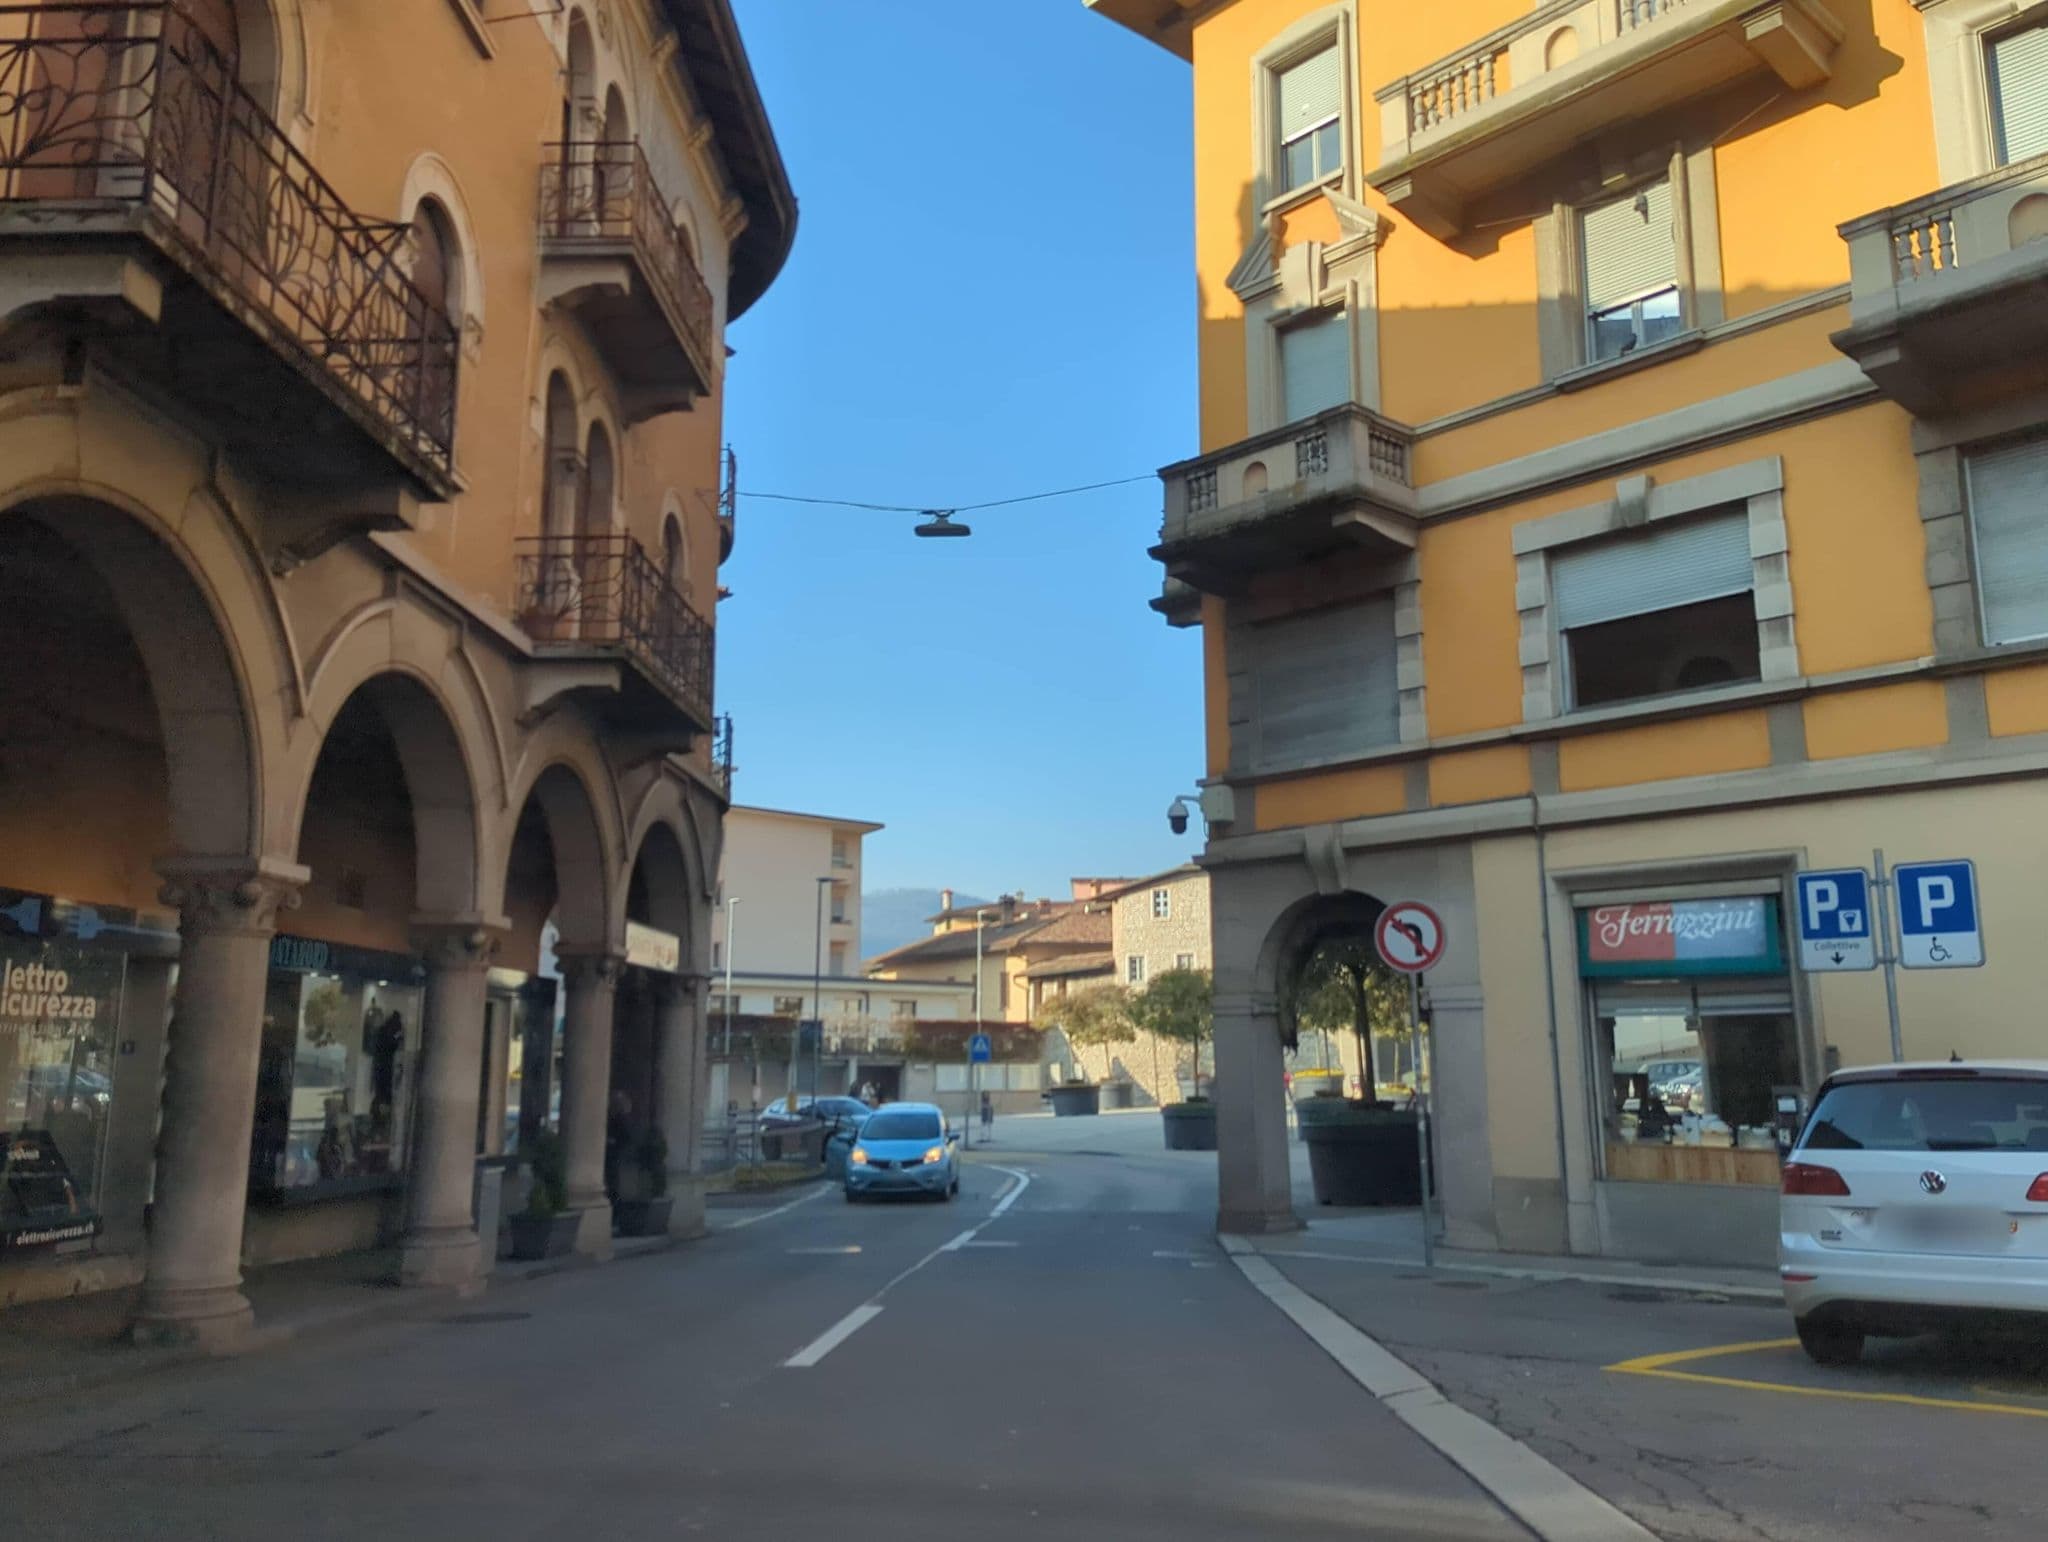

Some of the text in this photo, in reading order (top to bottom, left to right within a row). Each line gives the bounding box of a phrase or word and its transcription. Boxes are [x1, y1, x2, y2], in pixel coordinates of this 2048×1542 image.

[1594, 901, 1754, 948] Ferrazzini
[1806, 880, 1839, 930] P
[1917, 875, 1955, 927] P
